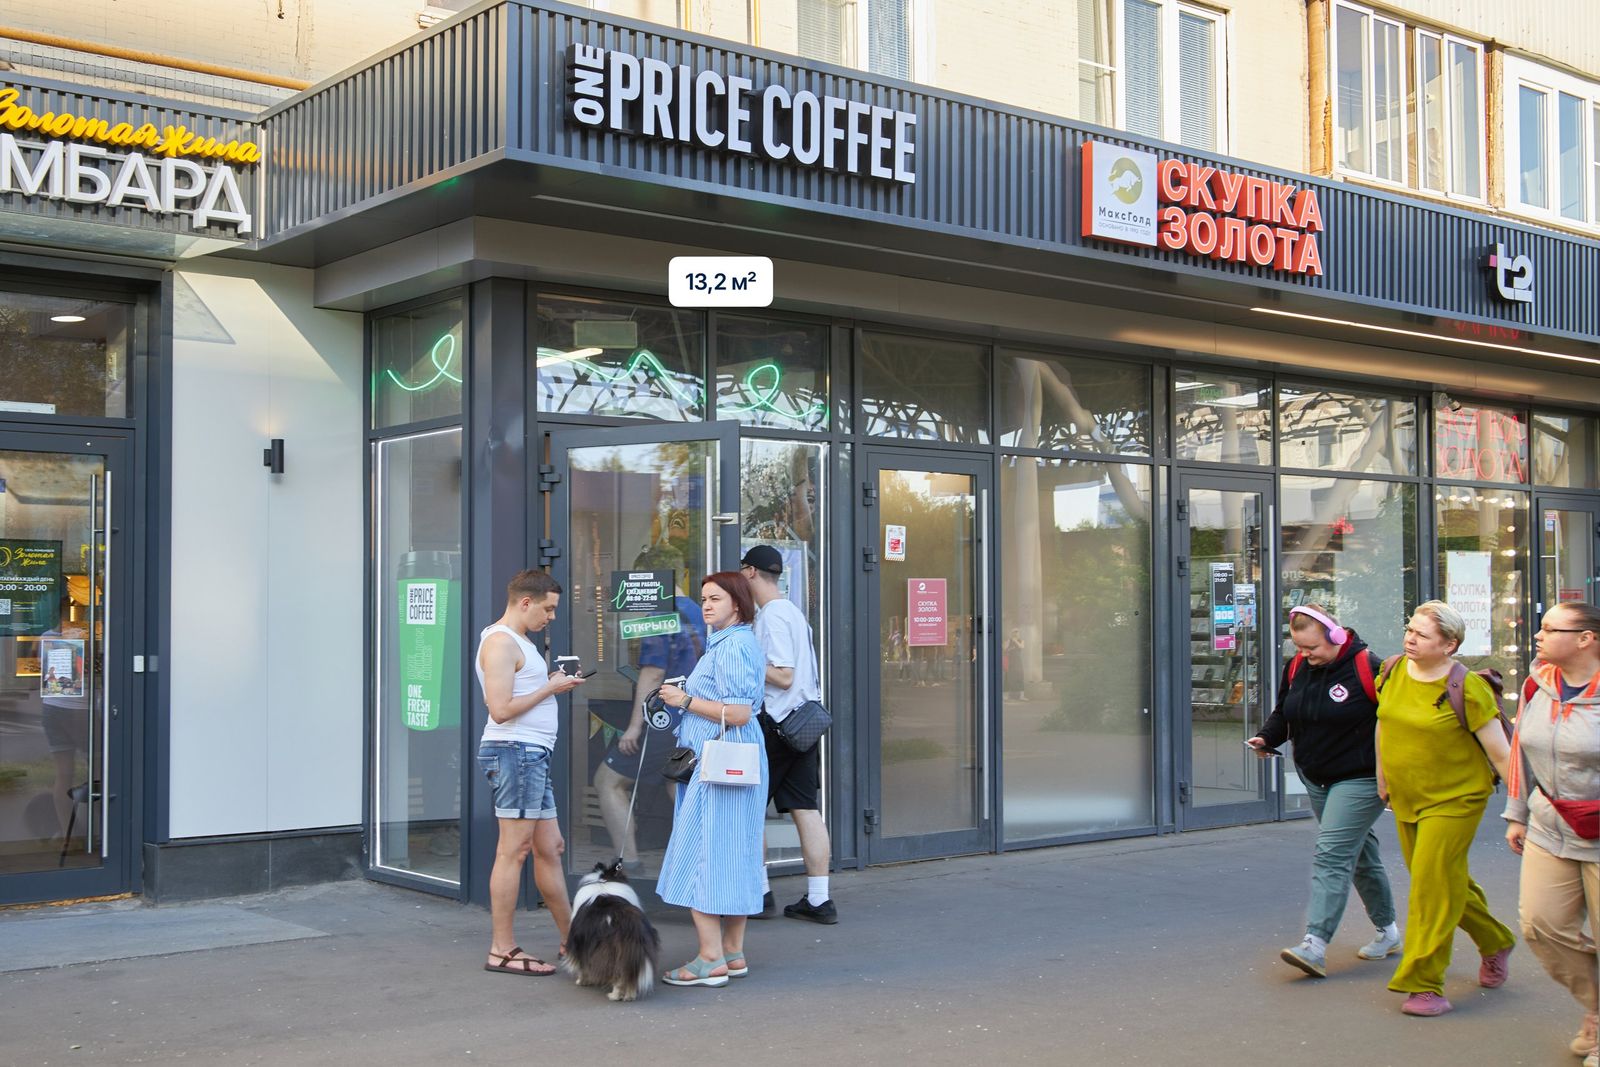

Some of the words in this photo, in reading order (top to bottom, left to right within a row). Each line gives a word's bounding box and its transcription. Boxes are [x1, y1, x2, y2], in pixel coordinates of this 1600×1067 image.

[573, 42, 605, 125] ONE
[609, 50, 752, 153] PRICE
[762, 84, 917, 184] COFFEE
[153, 125, 262, 164] Жила
[1160, 158, 1325, 232] СКУПКА
[1098, 205, 1152, 227] МаксГолд
[1160, 206, 1324, 276] ЗОЛОТА
[1488, 242, 1533, 302] t2
[24, 584, 47, 592] 20:00
[414, 588, 433, 603] PRICE
[1450, 583, 1488, 597] СКУПКА
[409, 604, 433, 620] COFFEE
[623, 619, 677, 634] ОТКРЫТО
[408, 684, 422, 698] ONE
[408, 699, 430, 713] FRESH
[408, 712, 429, 727] TASTE
